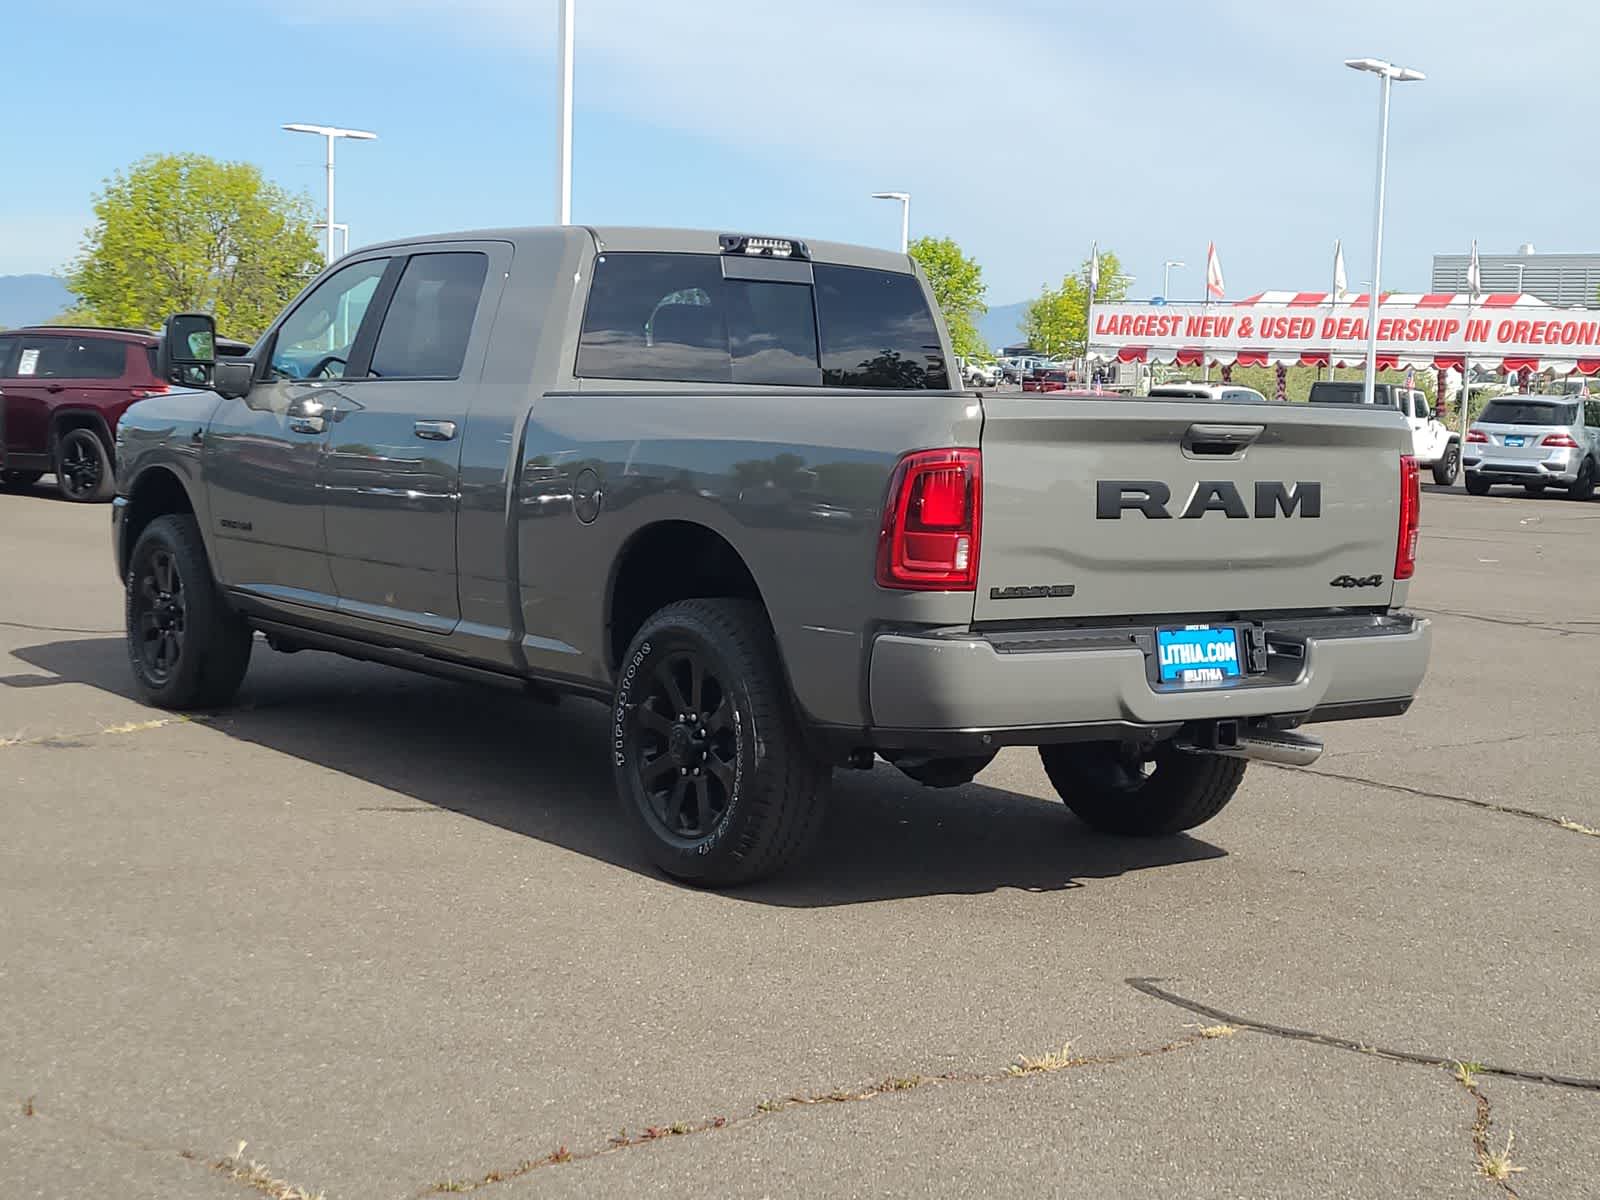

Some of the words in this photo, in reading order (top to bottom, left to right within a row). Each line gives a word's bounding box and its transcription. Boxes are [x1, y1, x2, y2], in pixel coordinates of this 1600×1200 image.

[1095, 314, 1183, 337] LARGEST
[1186, 315, 1234, 338] NEW
[1237, 316, 1255, 338] &
[1260, 316, 1316, 340] USED
[1464, 319, 1492, 343] IN
[1096, 480, 1321, 519] RAM
[1160, 641, 1237, 666] LITHIA.COM
